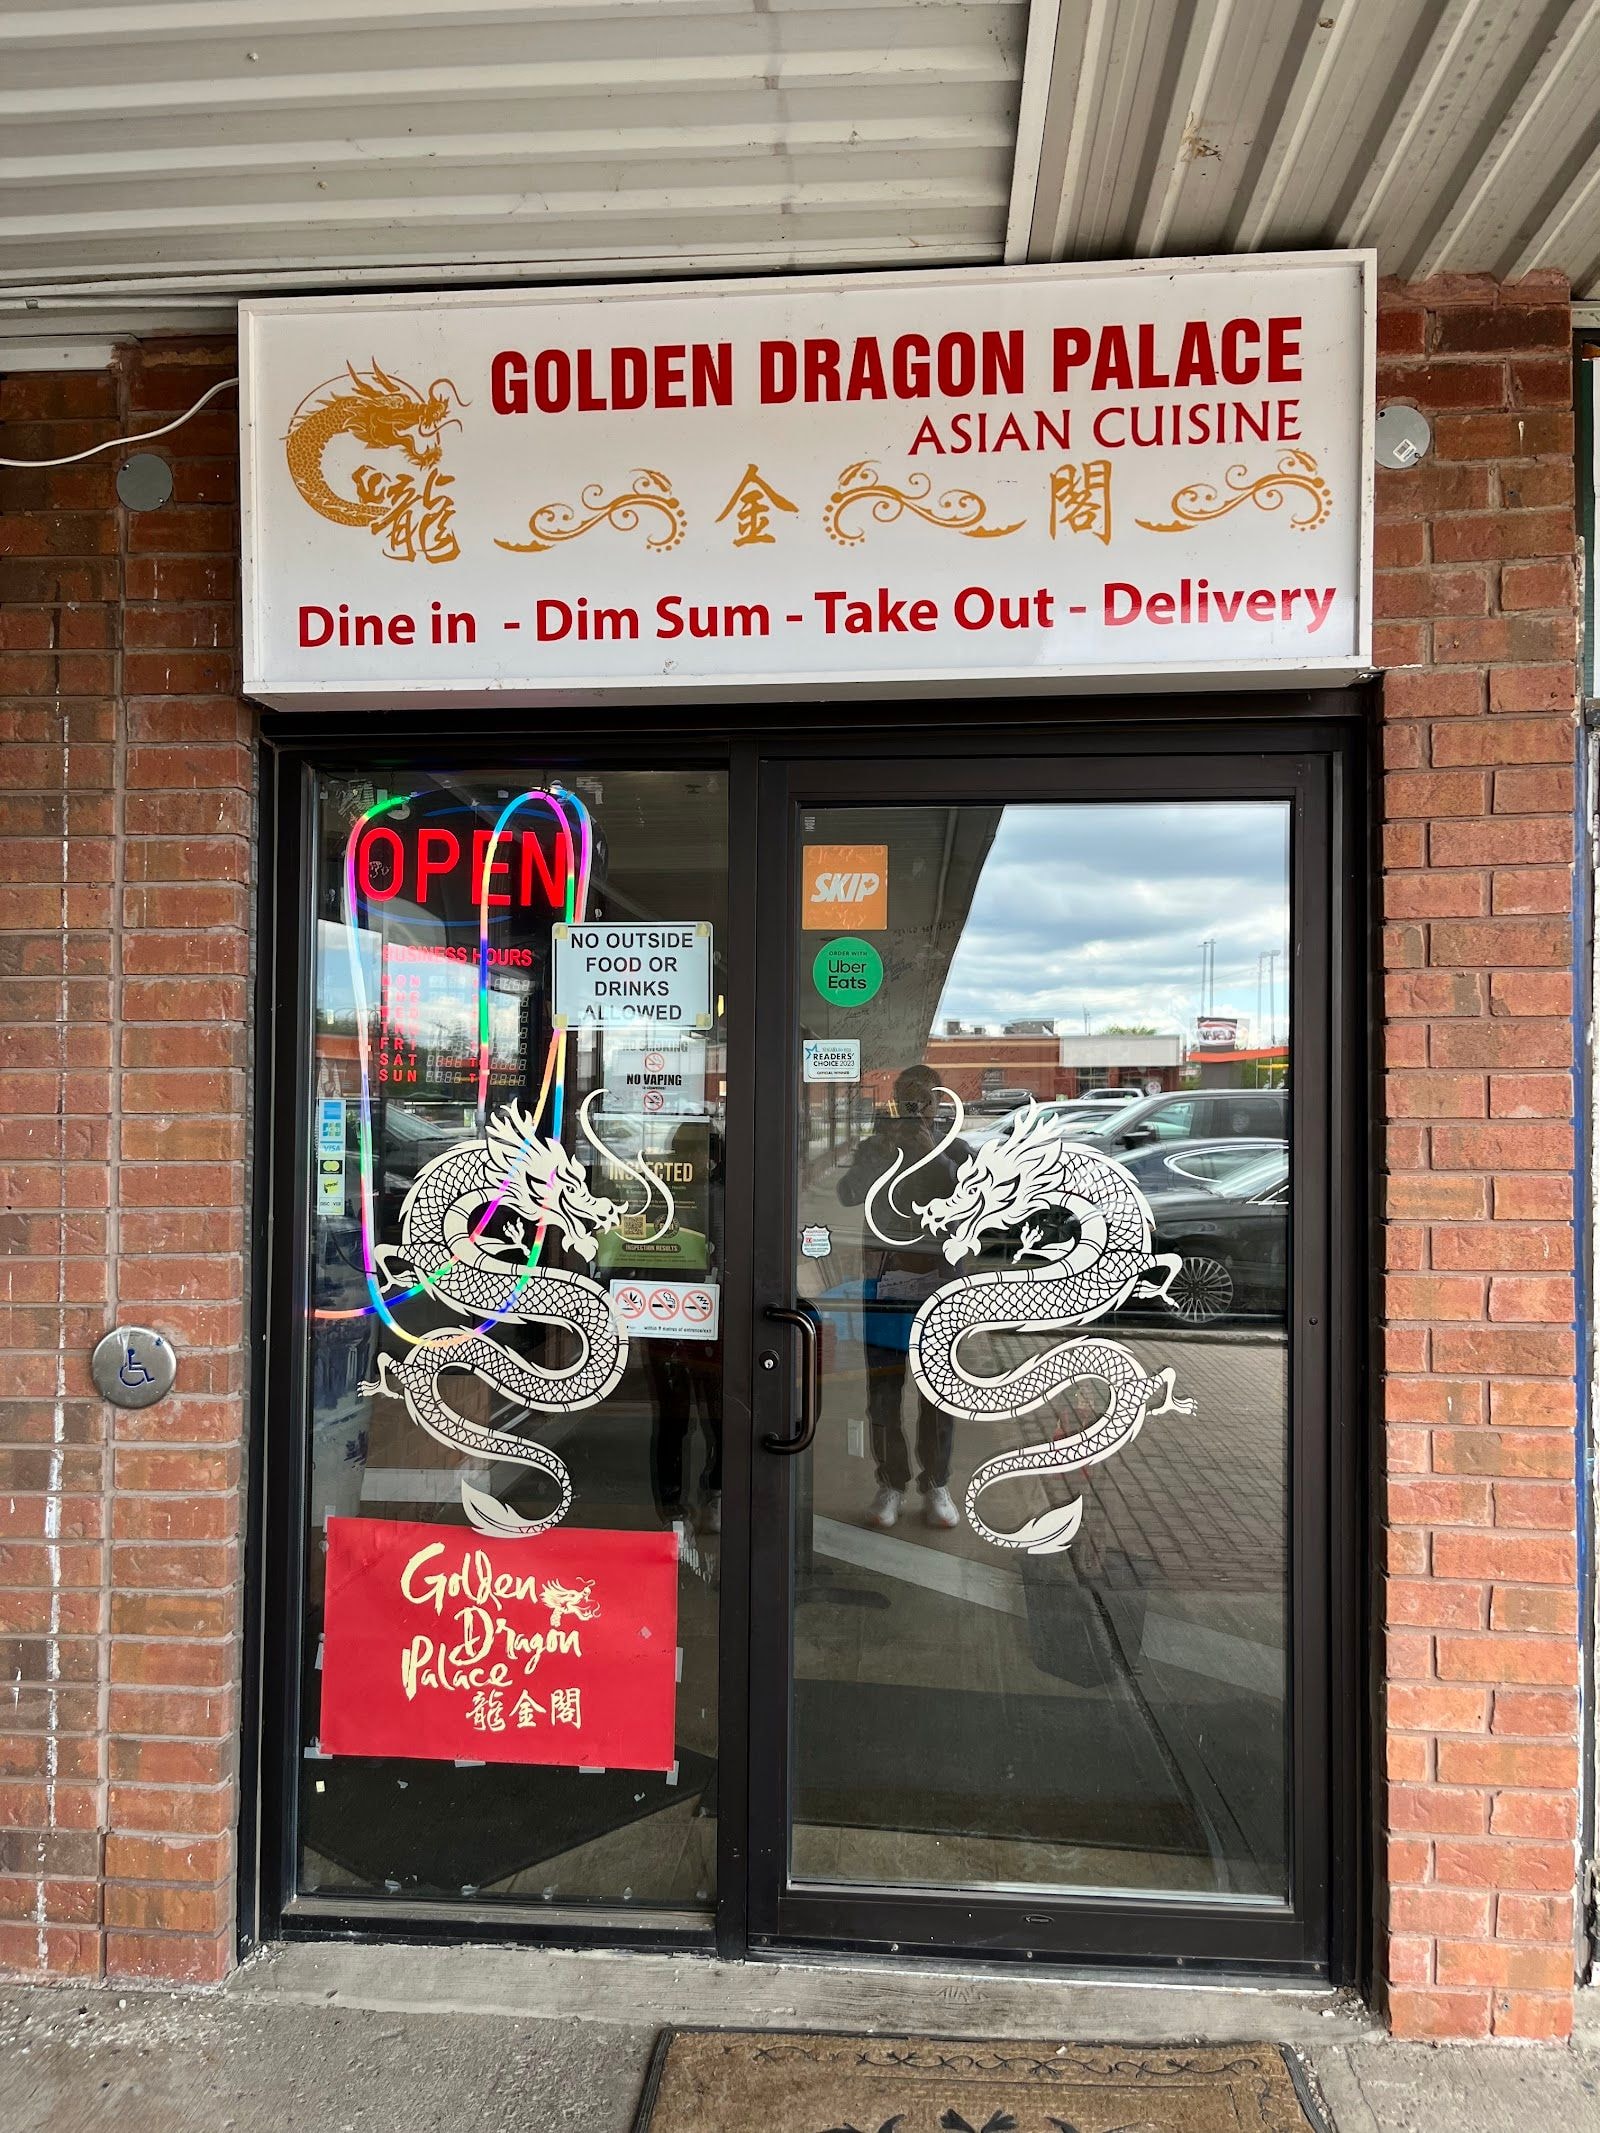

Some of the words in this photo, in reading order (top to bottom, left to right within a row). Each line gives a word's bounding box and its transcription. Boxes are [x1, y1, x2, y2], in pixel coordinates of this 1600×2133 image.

[490, 342, 733, 415] GOLDEN
[760, 329, 1025, 404] DRAGON
[1052, 316, 1303, 394] PALACE
[908, 410, 1071, 456] ASIAN
[1092, 399, 1302, 449] CUISINE
[716, 463, 800, 549] 金
[1048, 459, 1113, 546] 閣
[298, 603, 416, 648] Dine
[431, 601, 477, 645] in
[535, 597, 640, 643] Dim
[655, 595, 770, 640] Sum
[813, 587, 939, 635] Take
[953, 585, 1055, 631] Out
[1103, 577, 1337, 632] Delivery
[359, 827, 569, 907] OPEN
[810, 872, 880, 903] SKIP
[571, 932, 599, 949] NO
[607, 932, 694, 949] OUTSIDE
[472, 947, 532, 967] HOURS
[586, 956, 641, 973] FOOD
[648, 956, 678, 973] OR
[828, 959, 867, 973] Uber
[595, 980, 669, 997] DRINKS
[828, 975, 867, 989] Eats
[583, 1004, 682, 1021] ALLOWED
[380, 1037, 416, 1050] FRI
[379, 1053, 417, 1066] SAT
[378, 1069, 417, 1082] SUN
[626, 1073, 641, 1085] NO
[643, 1073, 682, 1086] VAPING
[400, 1541, 538, 1616] Golden
[448, 1605, 583, 1675] Dragon
[402, 1635, 513, 1702] Palace
[464, 1687, 582, 1732] 龍金閣
